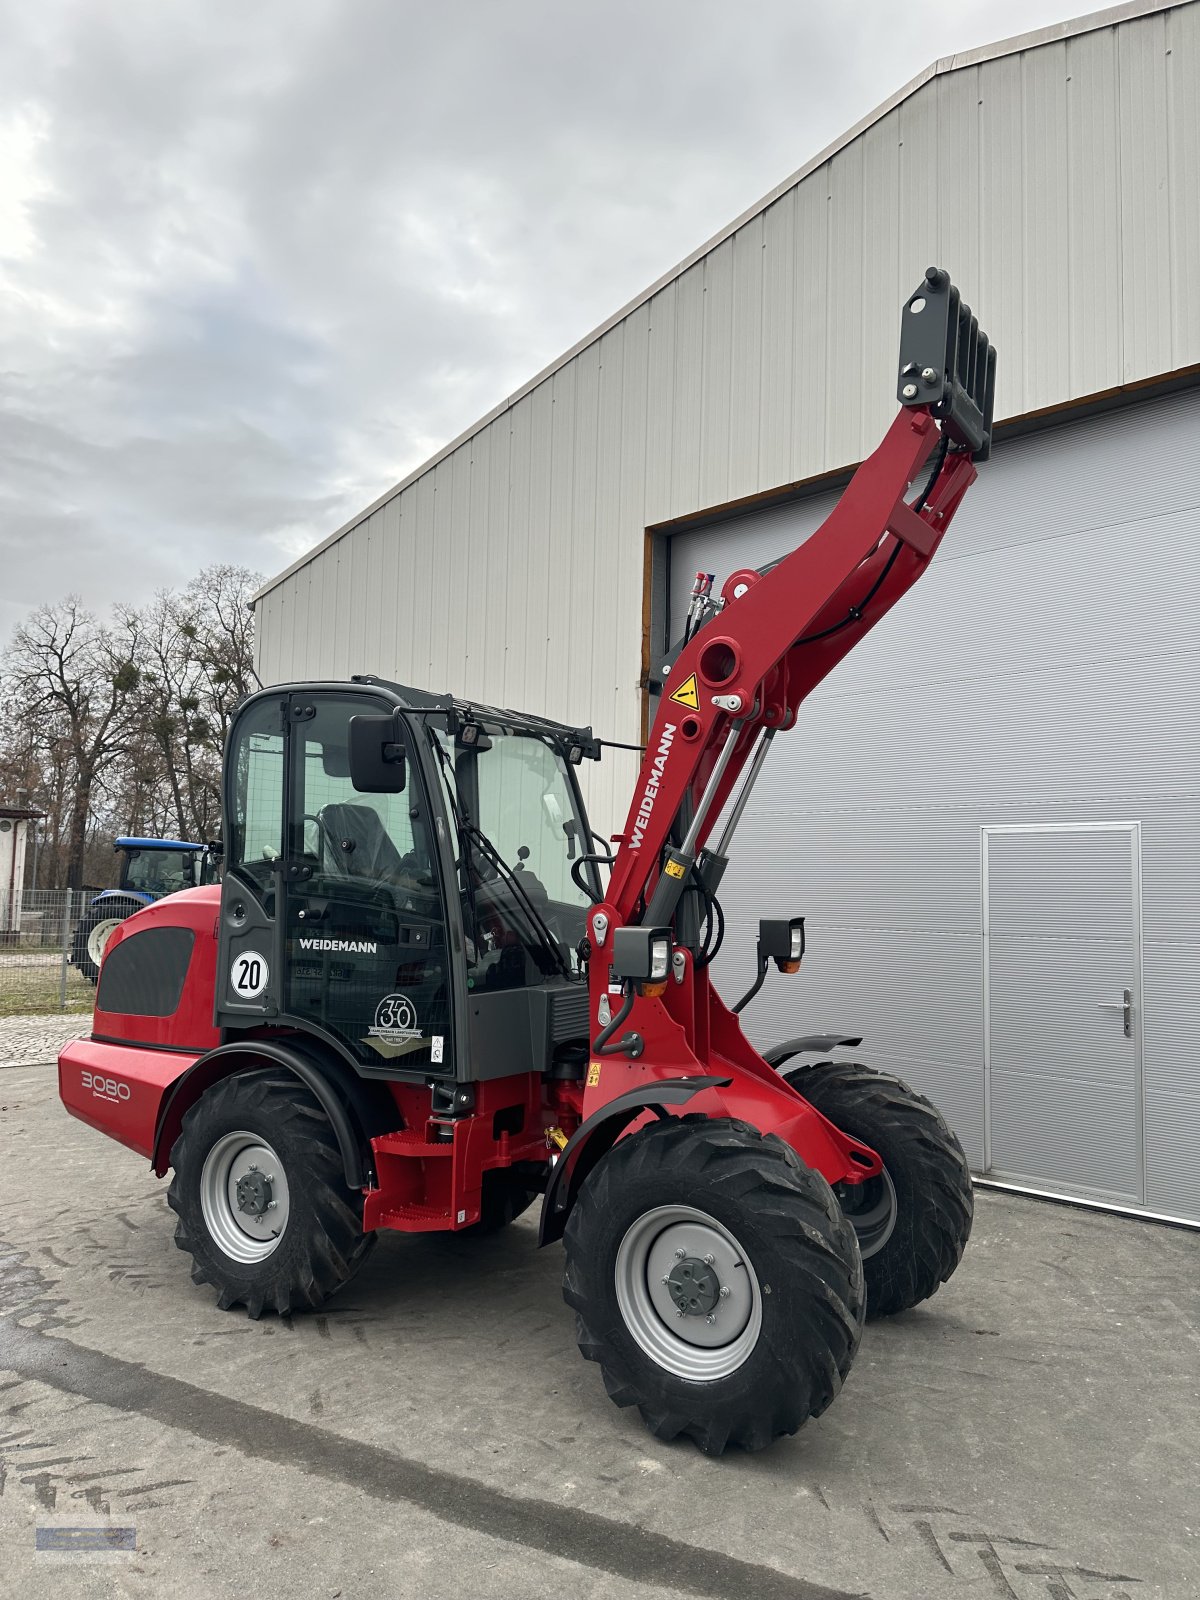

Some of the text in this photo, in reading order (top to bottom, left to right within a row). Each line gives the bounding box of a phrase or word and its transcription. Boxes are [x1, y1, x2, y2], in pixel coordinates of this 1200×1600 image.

[628, 722, 677, 849] WEIDEMANN
[299, 938, 377, 954] WEIDEMANN
[238, 959, 261, 990] 20
[81, 1070, 131, 1100] 3080
